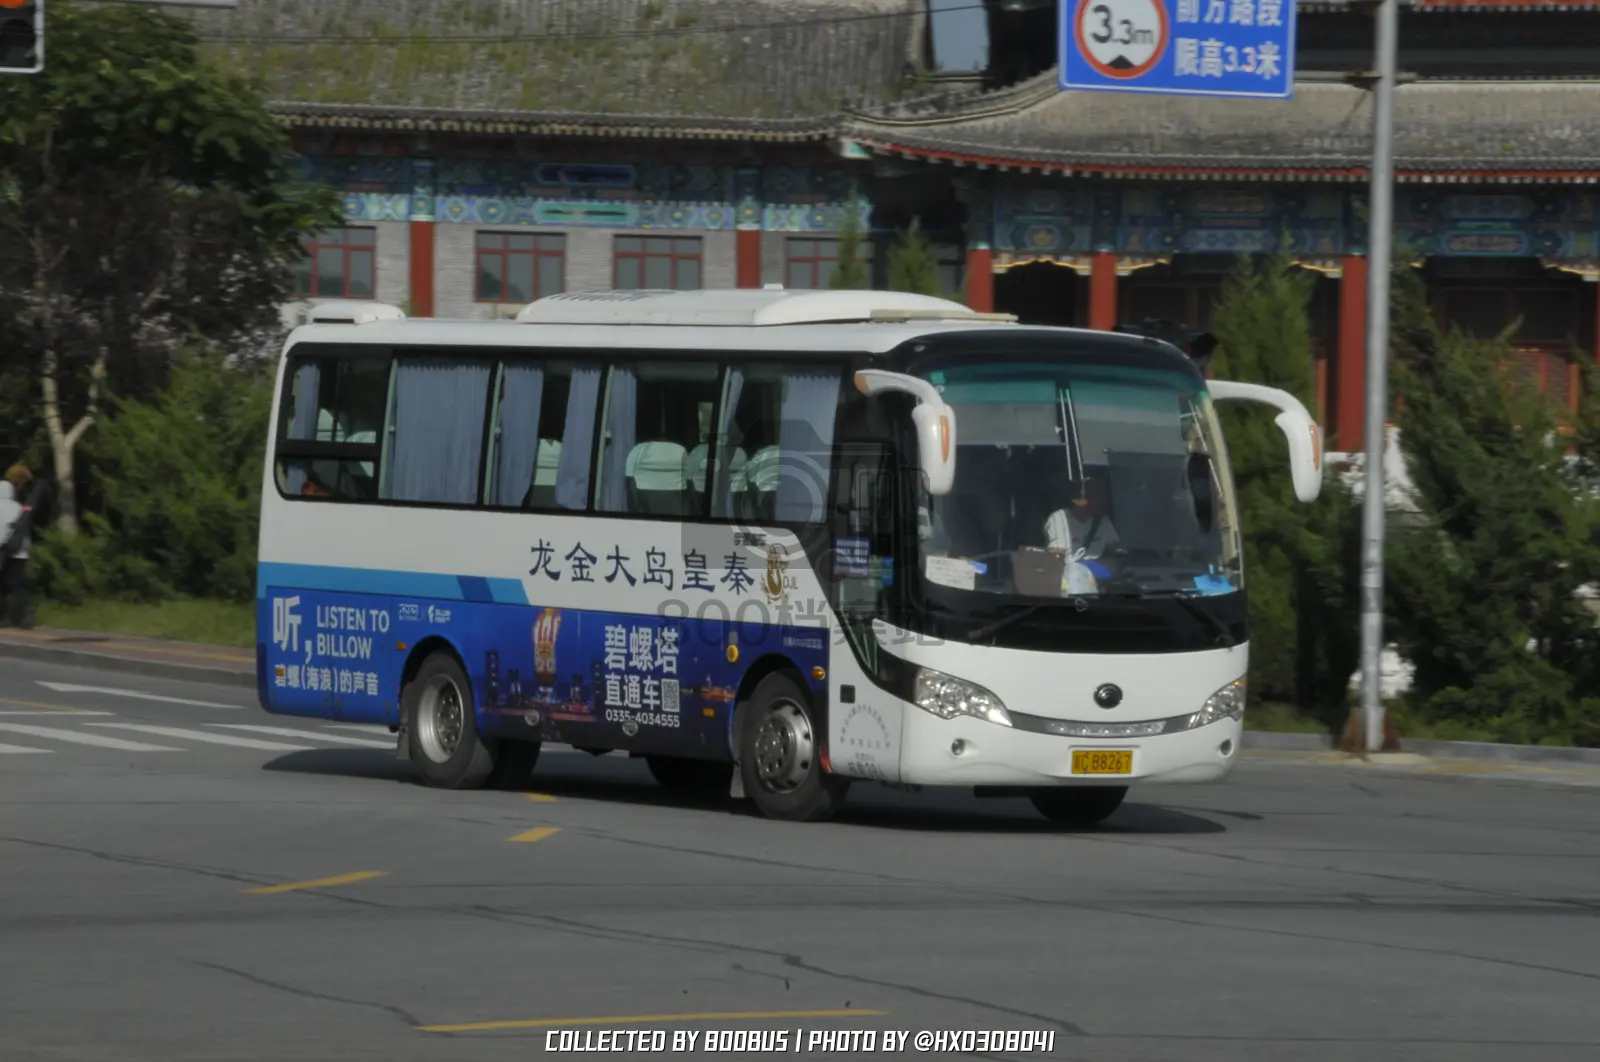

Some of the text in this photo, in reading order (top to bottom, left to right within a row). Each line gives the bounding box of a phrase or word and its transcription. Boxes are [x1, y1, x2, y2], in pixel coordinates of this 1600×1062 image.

[1091, 5, 1154, 45] 3.3m
[1174, 37, 1282, 80] 限高3.3米
[316, 604, 366, 631] LISTEN
[369, 608, 391, 634] TO
[316, 633, 372, 660] BILLOW
[604, 624, 680, 674] 碧螺塔
[604, 673, 661, 711] 直通车
[605, 708, 681, 728] 0335-4034555
